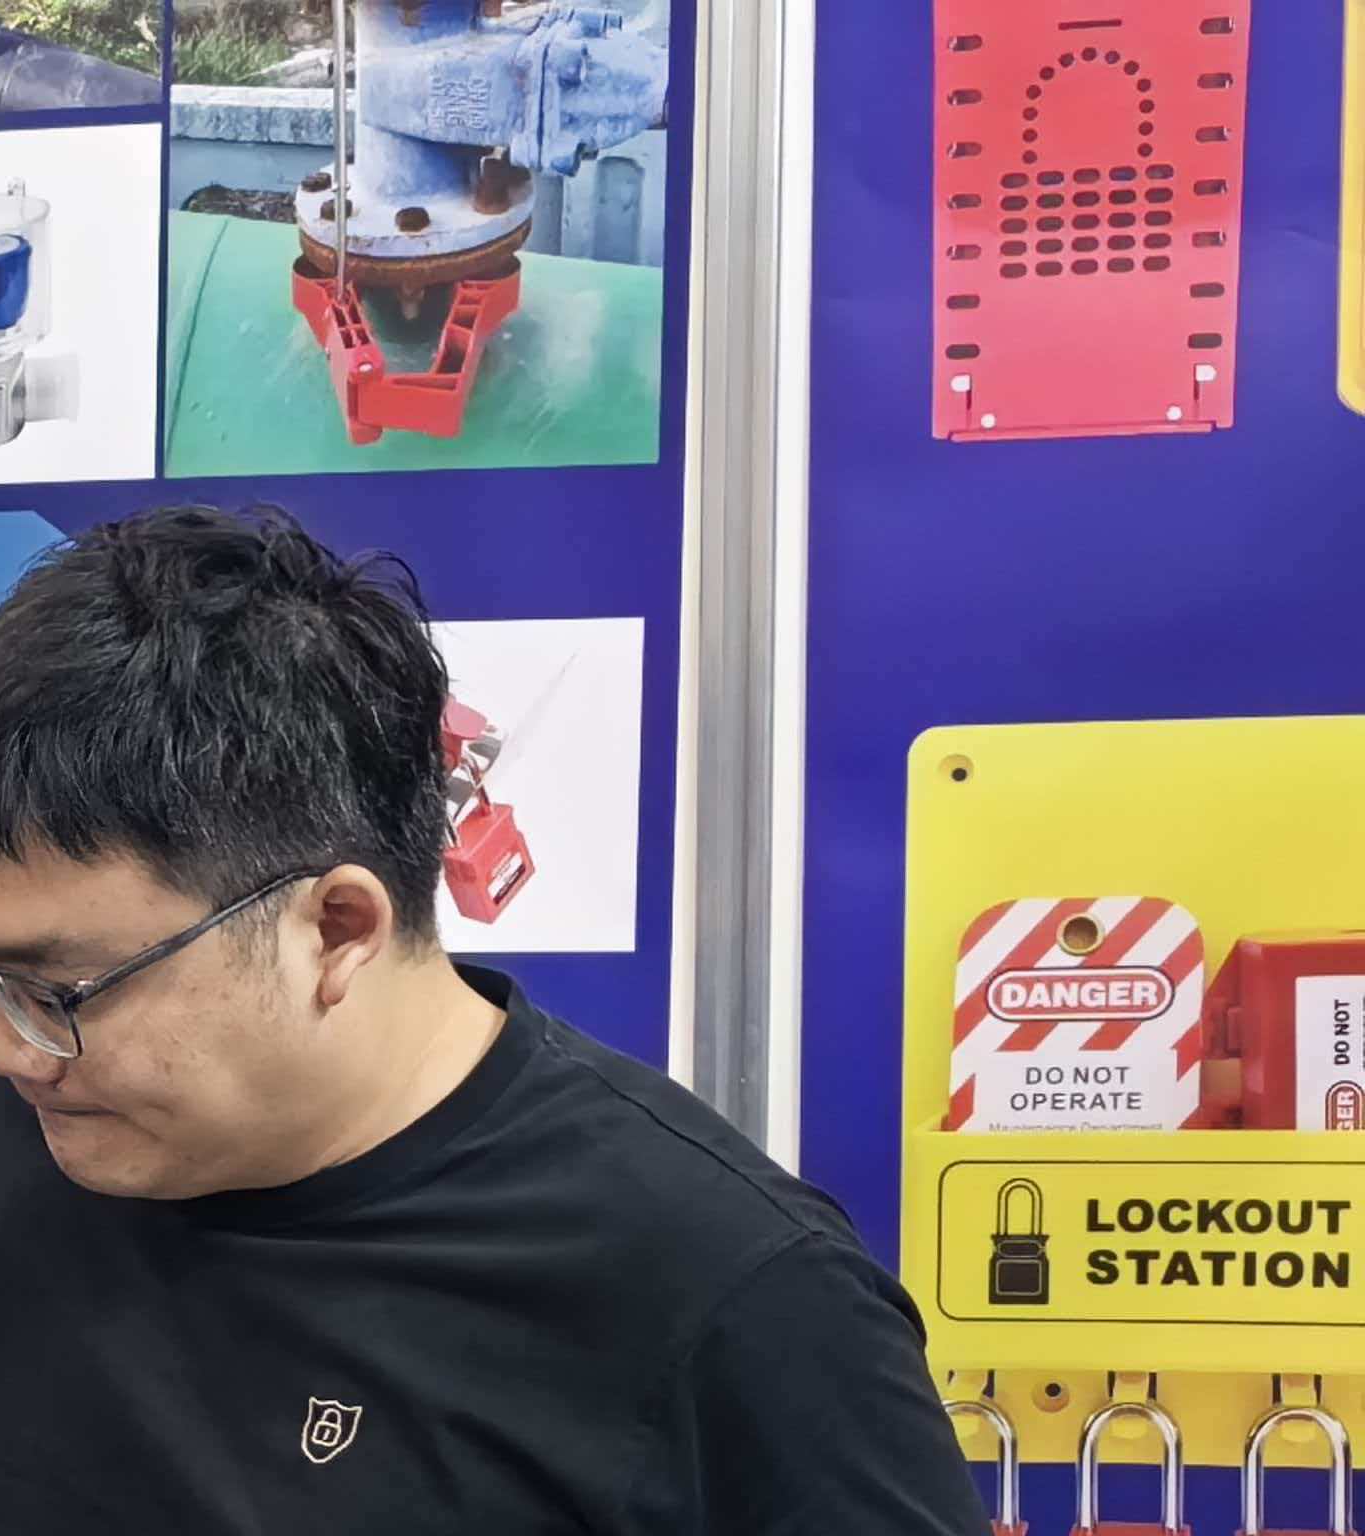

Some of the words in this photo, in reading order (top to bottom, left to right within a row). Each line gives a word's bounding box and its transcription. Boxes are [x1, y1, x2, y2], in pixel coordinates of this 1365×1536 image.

[1002, 981, 1159, 1010] DANGER
[1334, 1000, 1350, 1036] NOT
[1334, 1041, 1350, 1066] DO
[1026, 1066, 1065, 1085] DO
[1073, 1066, 1130, 1085] NOT
[1010, 1092, 1143, 1111] OPERATE
[1336, 1090, 1355, 1130] GER
[1086, 1199, 1351, 1234] LOCKOUT
[1086, 1251, 1350, 1288] STATION
